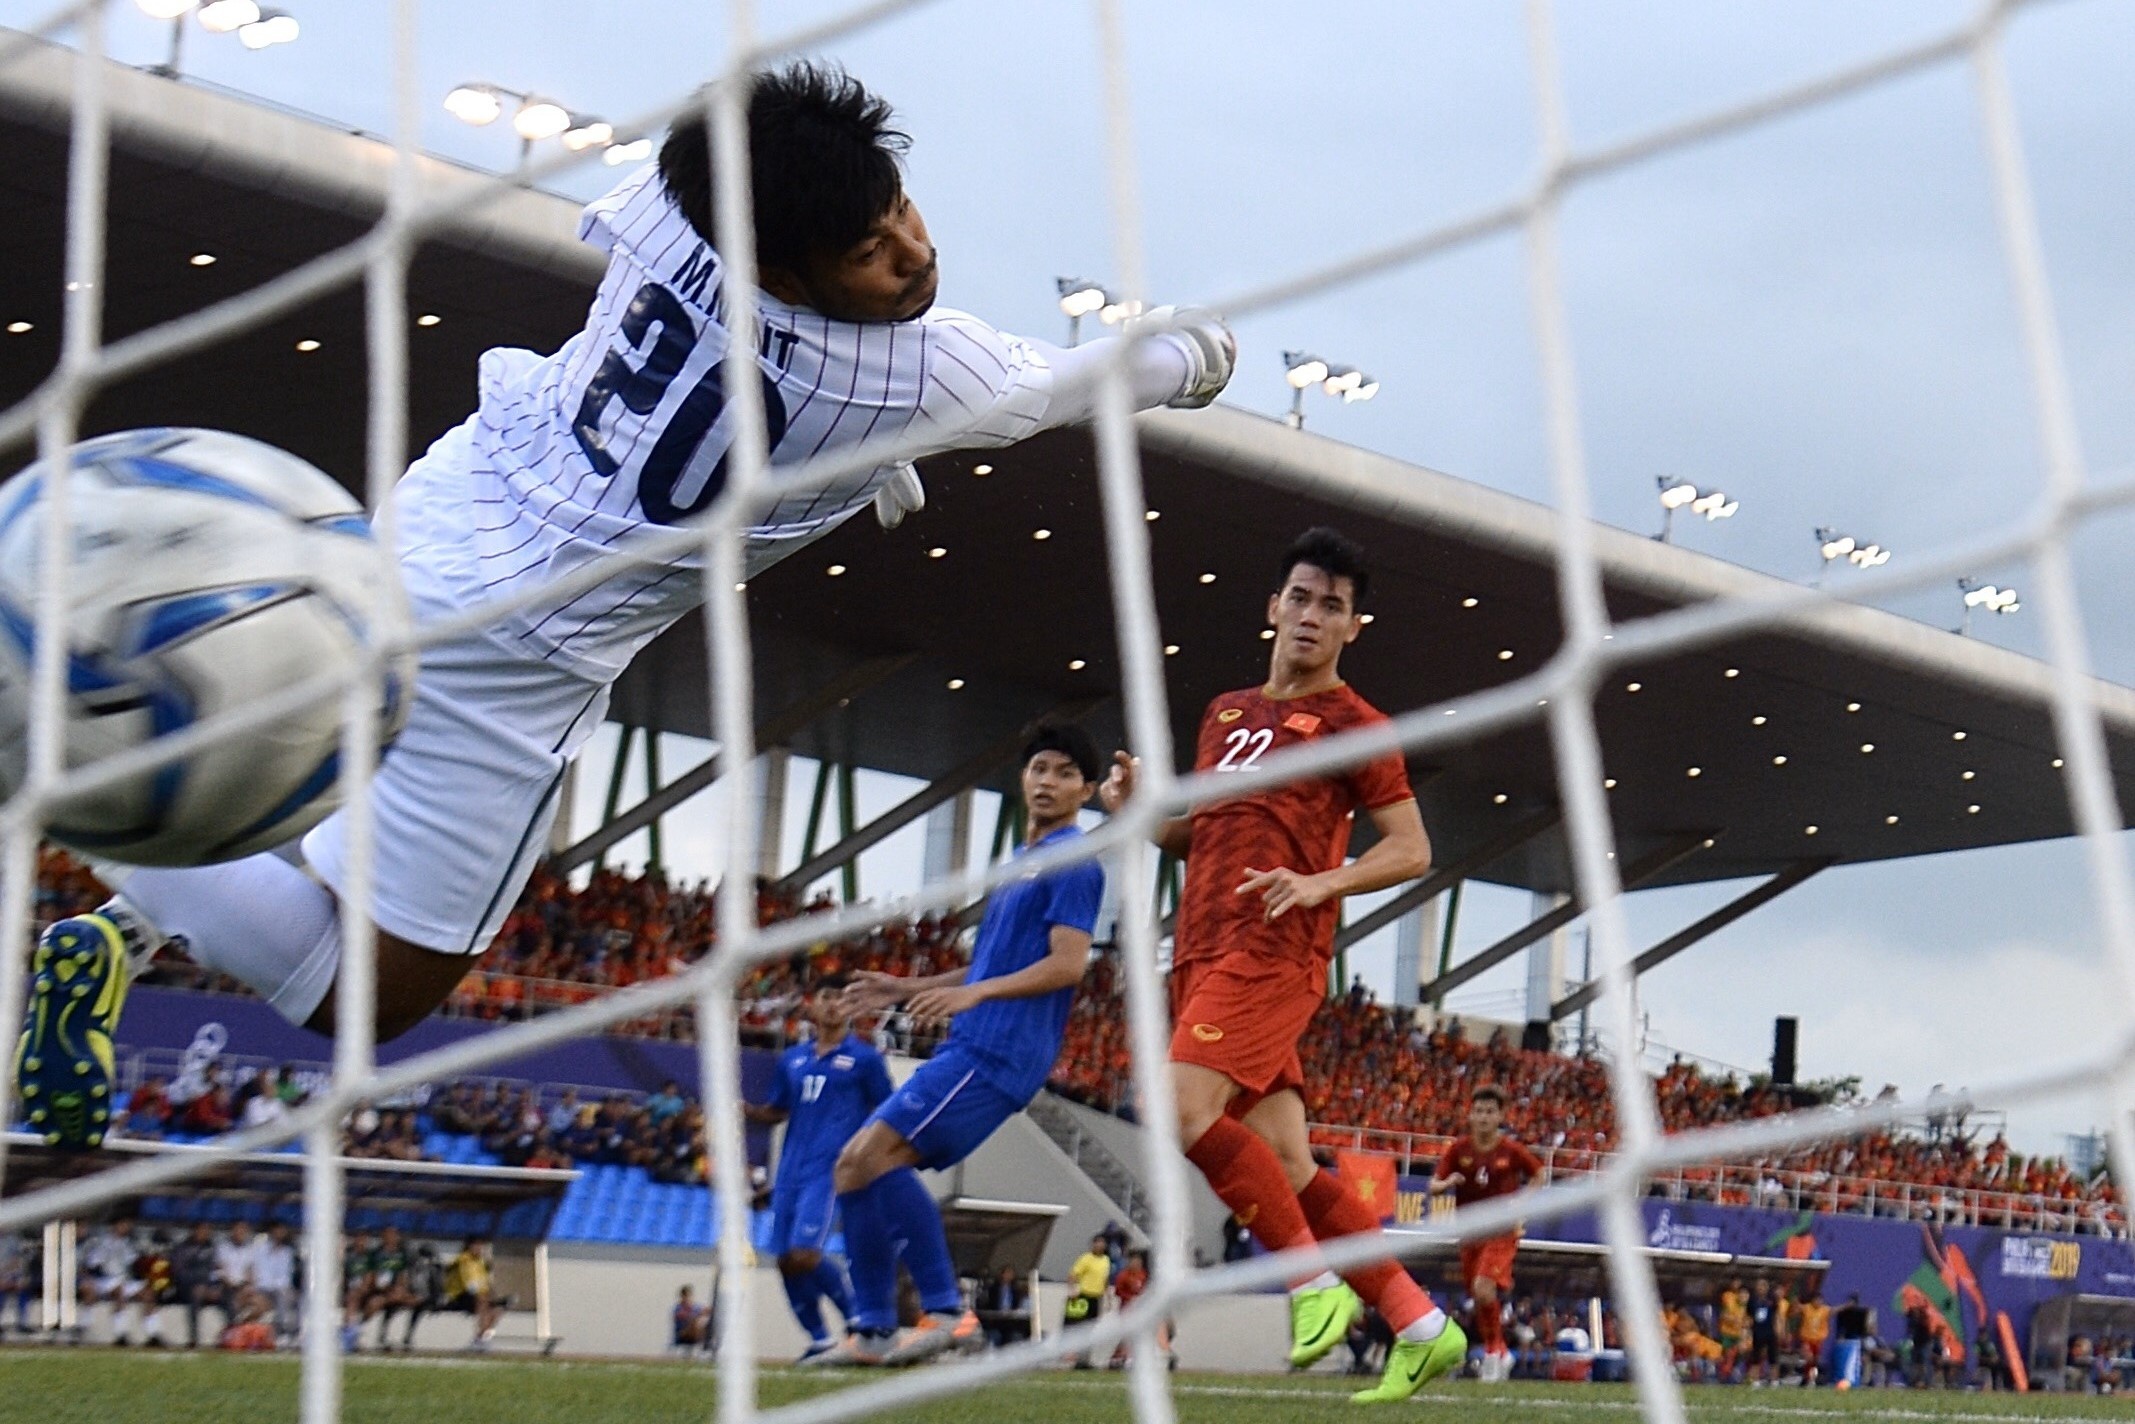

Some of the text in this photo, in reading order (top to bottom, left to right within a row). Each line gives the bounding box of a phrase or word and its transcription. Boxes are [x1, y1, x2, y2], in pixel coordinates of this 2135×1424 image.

[572, 281, 788, 526] 20
[1215, 728, 1274, 773] 22
[1474, 1165, 1489, 1186] 4
[1396, 1191, 1426, 1224] WE
